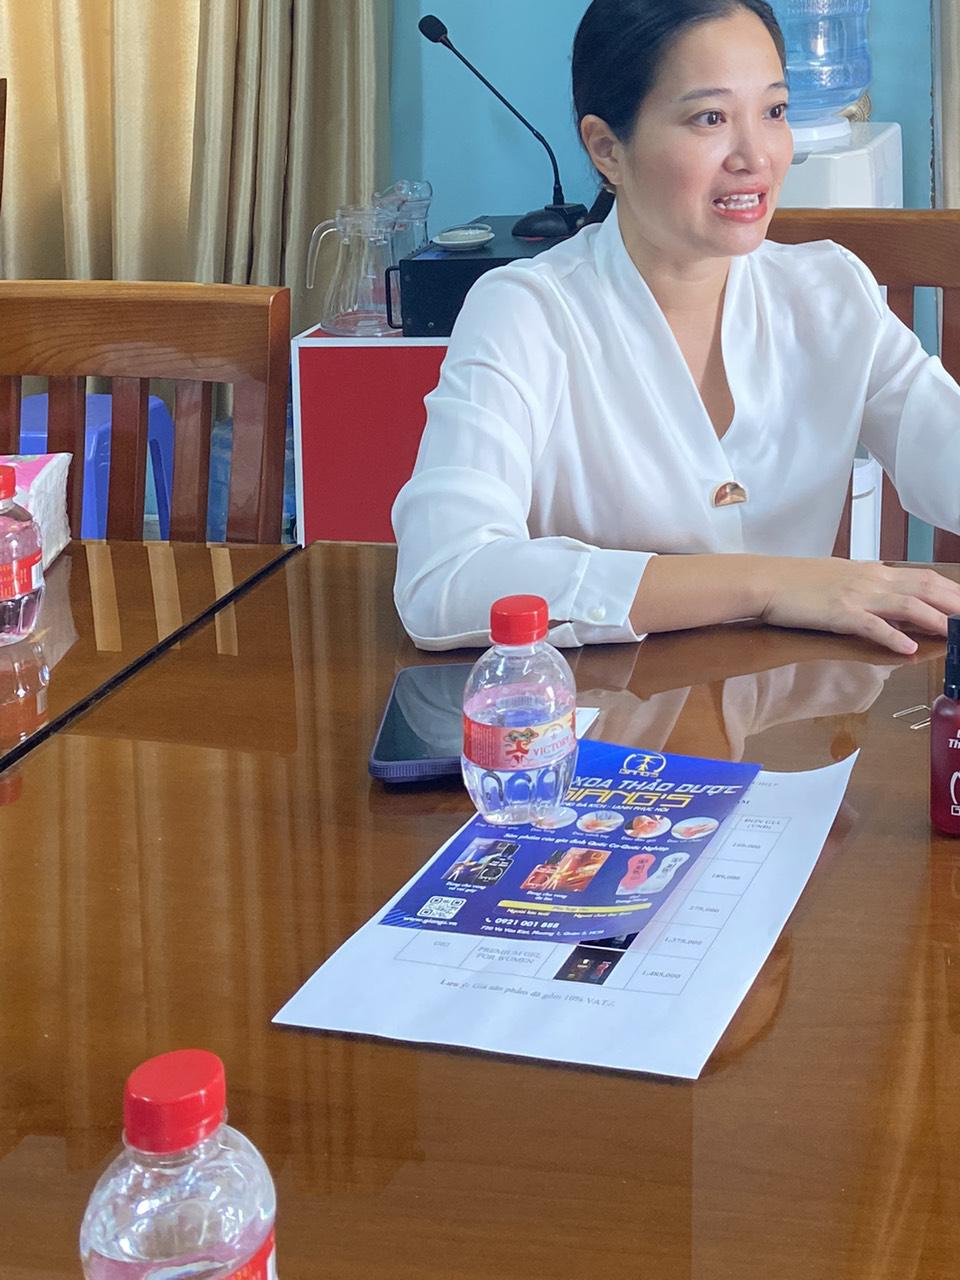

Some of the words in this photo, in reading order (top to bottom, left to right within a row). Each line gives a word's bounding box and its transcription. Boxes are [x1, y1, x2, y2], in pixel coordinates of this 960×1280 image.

[571, 776, 613, 788] XOA
[618, 778, 675, 792] THẢO
[675, 783, 743, 796] DƯỢC
[495, 917, 519, 926] 0921
[520, 919, 539, 927] 001
